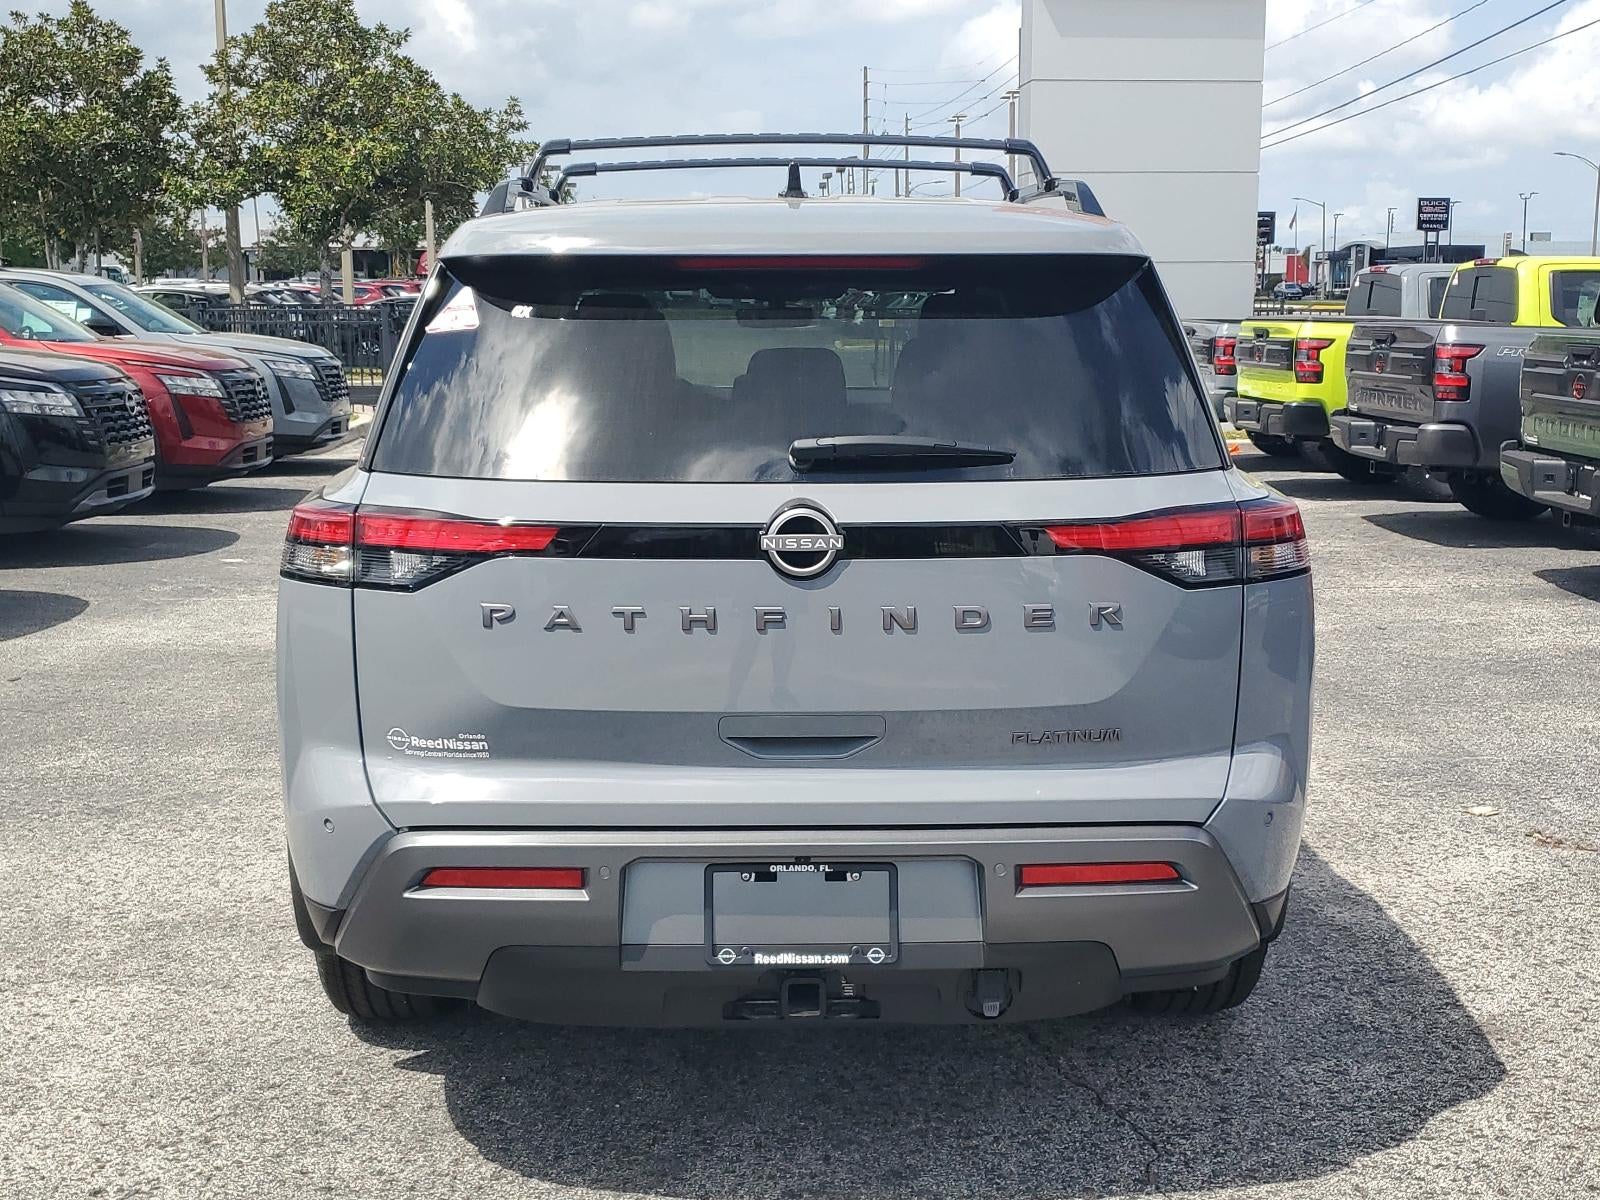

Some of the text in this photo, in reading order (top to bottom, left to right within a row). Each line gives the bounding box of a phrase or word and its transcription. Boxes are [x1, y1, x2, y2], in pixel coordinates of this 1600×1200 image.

[763, 537, 842, 549] NISSAN
[480, 600, 1124, 634] PATHFINDER
[1010, 728, 1121, 744] PLATINUM
[404, 748, 424, 758] Serving
[769, 864, 834, 873] ORLANDO, FL.
[754, 953, 850, 965] ReedNissan.com
